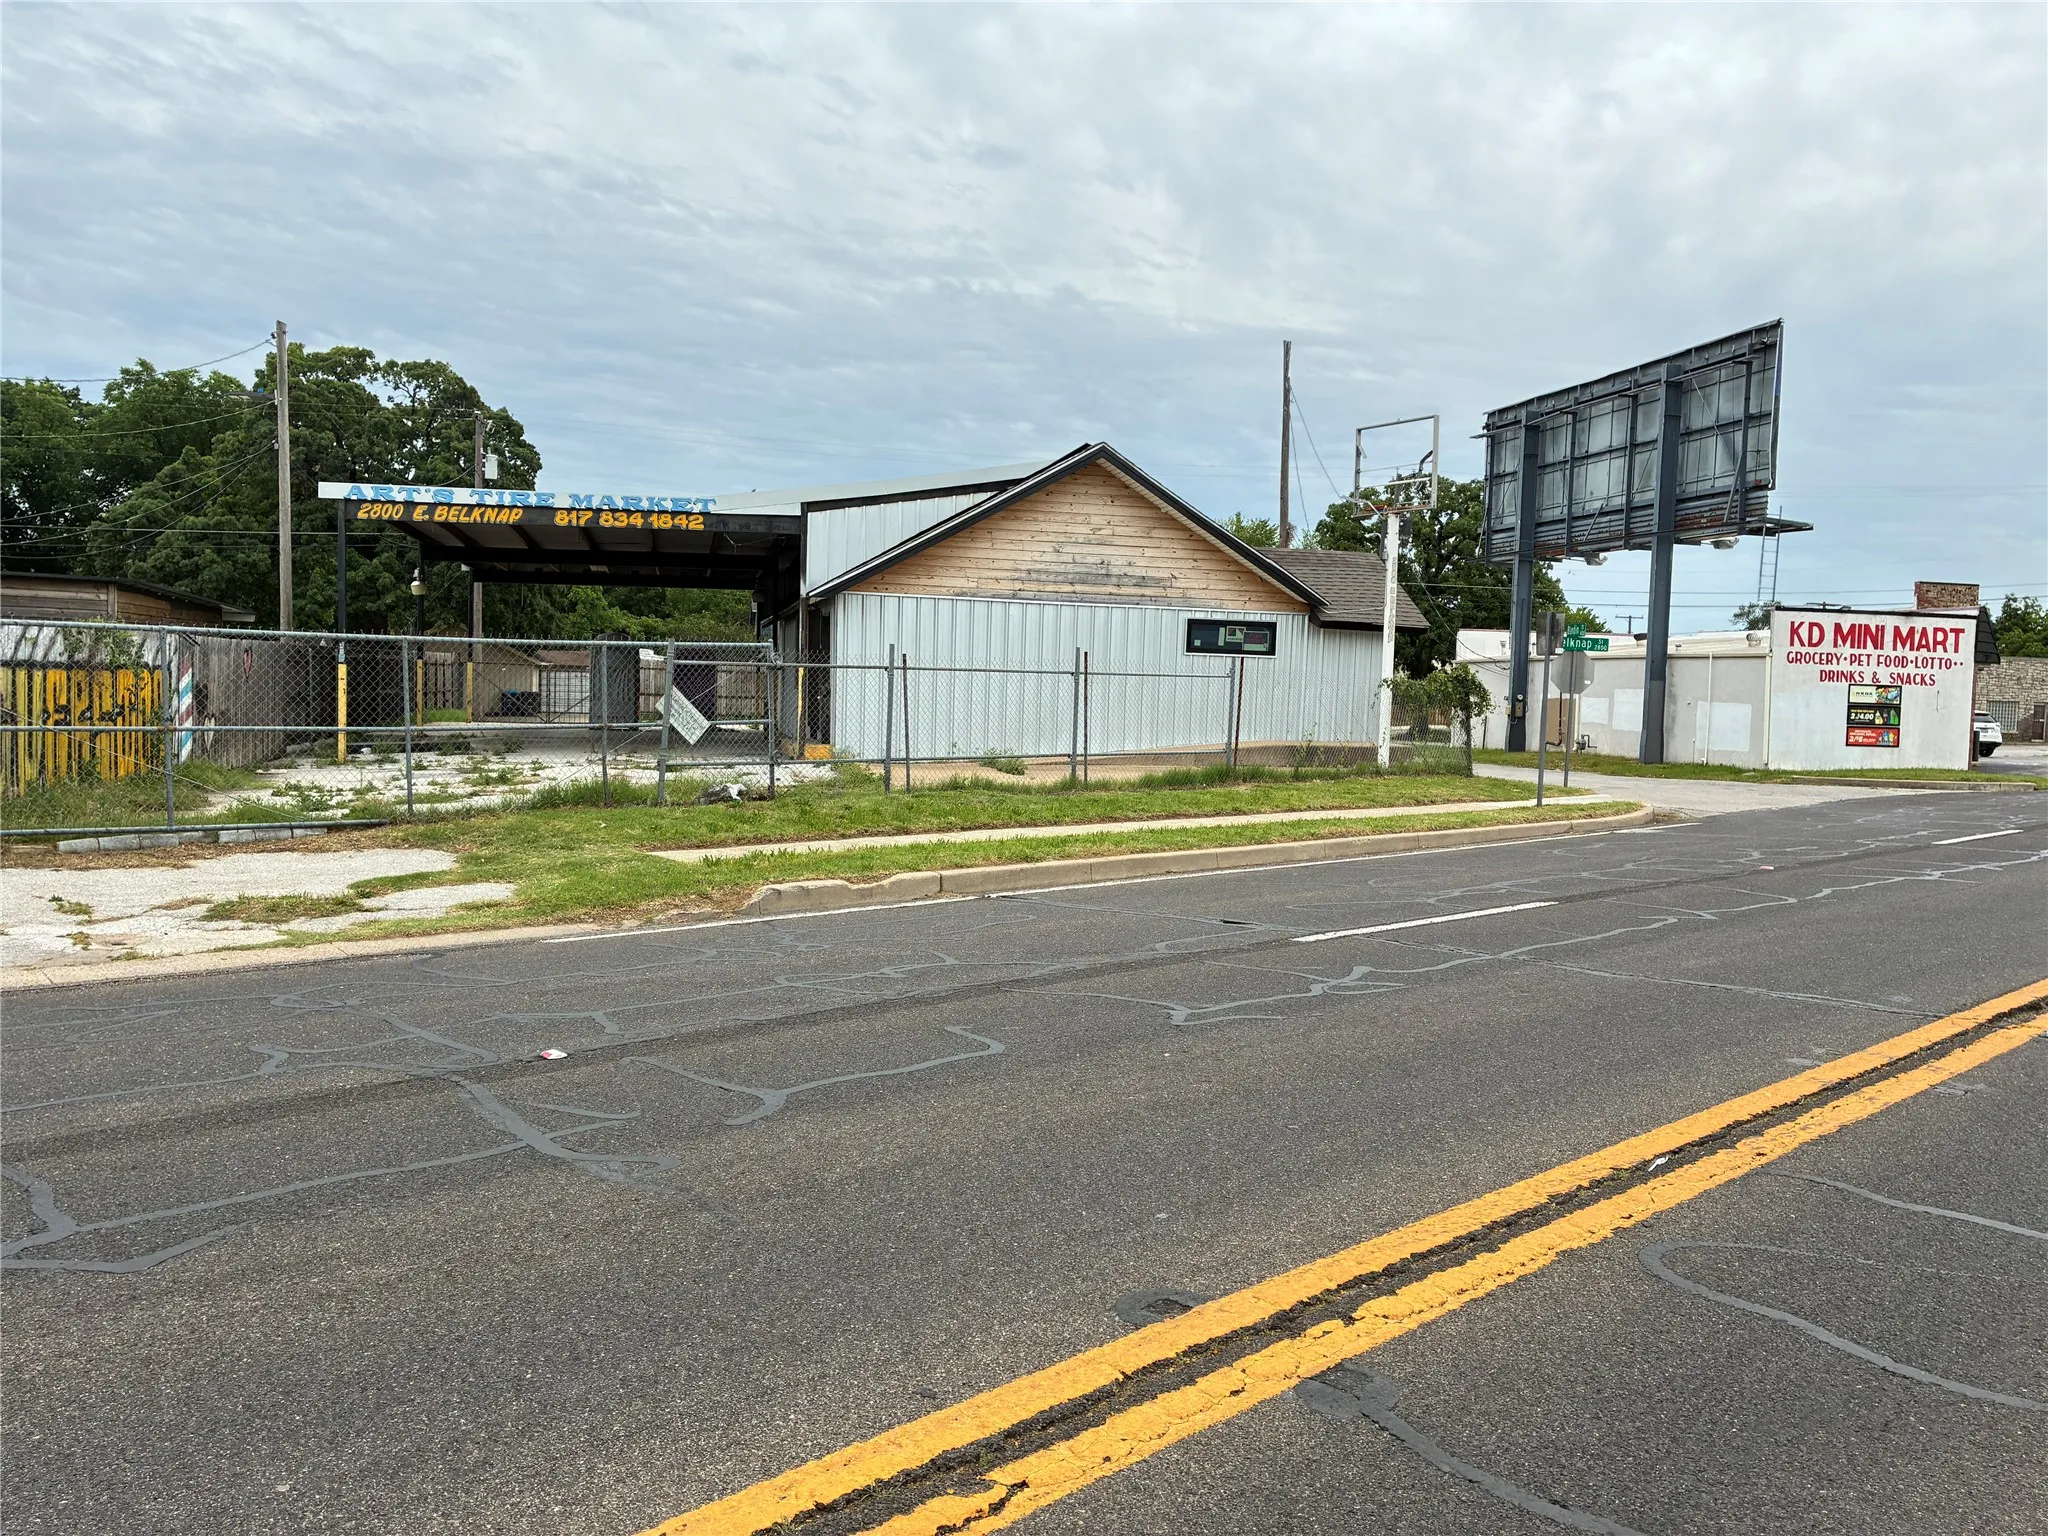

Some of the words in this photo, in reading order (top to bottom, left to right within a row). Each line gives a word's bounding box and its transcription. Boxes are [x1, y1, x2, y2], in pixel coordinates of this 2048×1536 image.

[343, 484, 455, 504] ART'S
[469, 489, 556, 508] TIRE
[569, 493, 717, 513] MARKET
[357, 502, 404, 520] 2800
[412, 504, 430, 522] E.
[434, 505, 523, 525] BELKNAP
[554, 510, 594, 527] 817
[599, 511, 644, 529] 834
[648, 513, 705, 531] 1842
[1790, 621, 1825, 648] KD
[1833, 622, 1885, 650] MINI
[1892, 625, 1965, 653] MART
[1820, 669, 1865, 684] DRINKS
[1871, 671, 1881, 684] &
[1889, 672, 1936, 687] SNACKS
